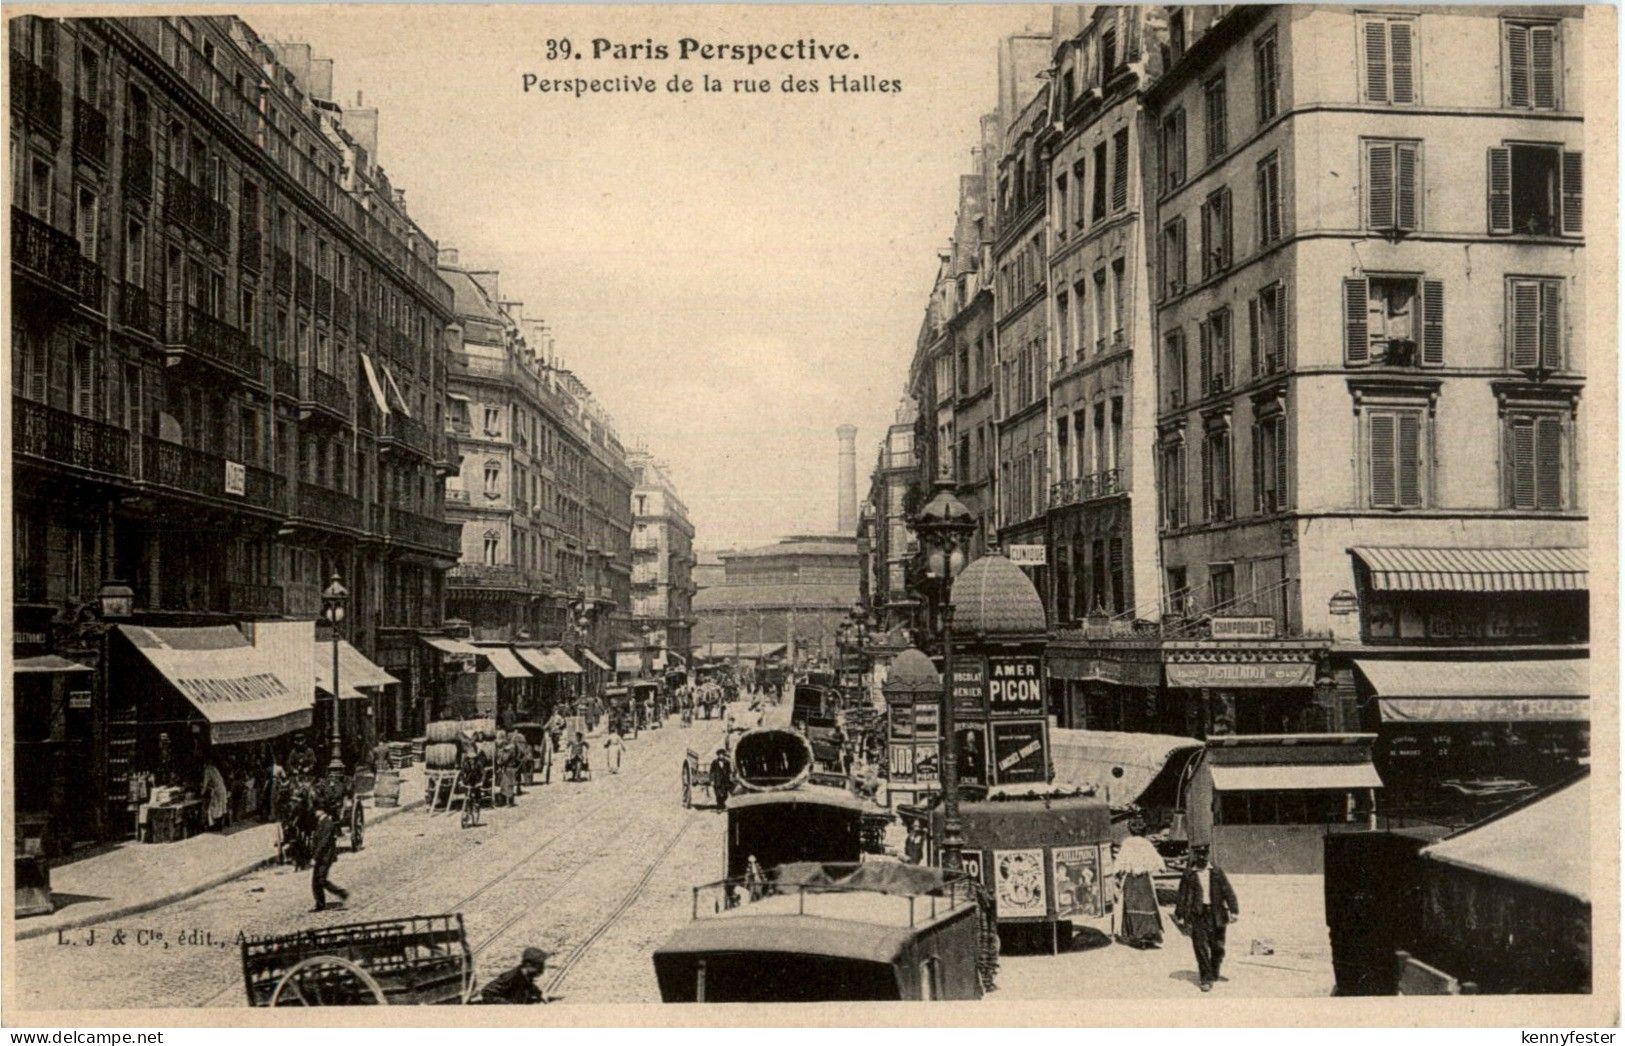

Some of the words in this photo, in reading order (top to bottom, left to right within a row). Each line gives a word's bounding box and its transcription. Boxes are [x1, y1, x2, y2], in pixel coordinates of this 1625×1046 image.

[994, 664, 1034, 676] AMER
[989, 680, 1040, 701] PICON
[890, 747, 914, 774] JOB
